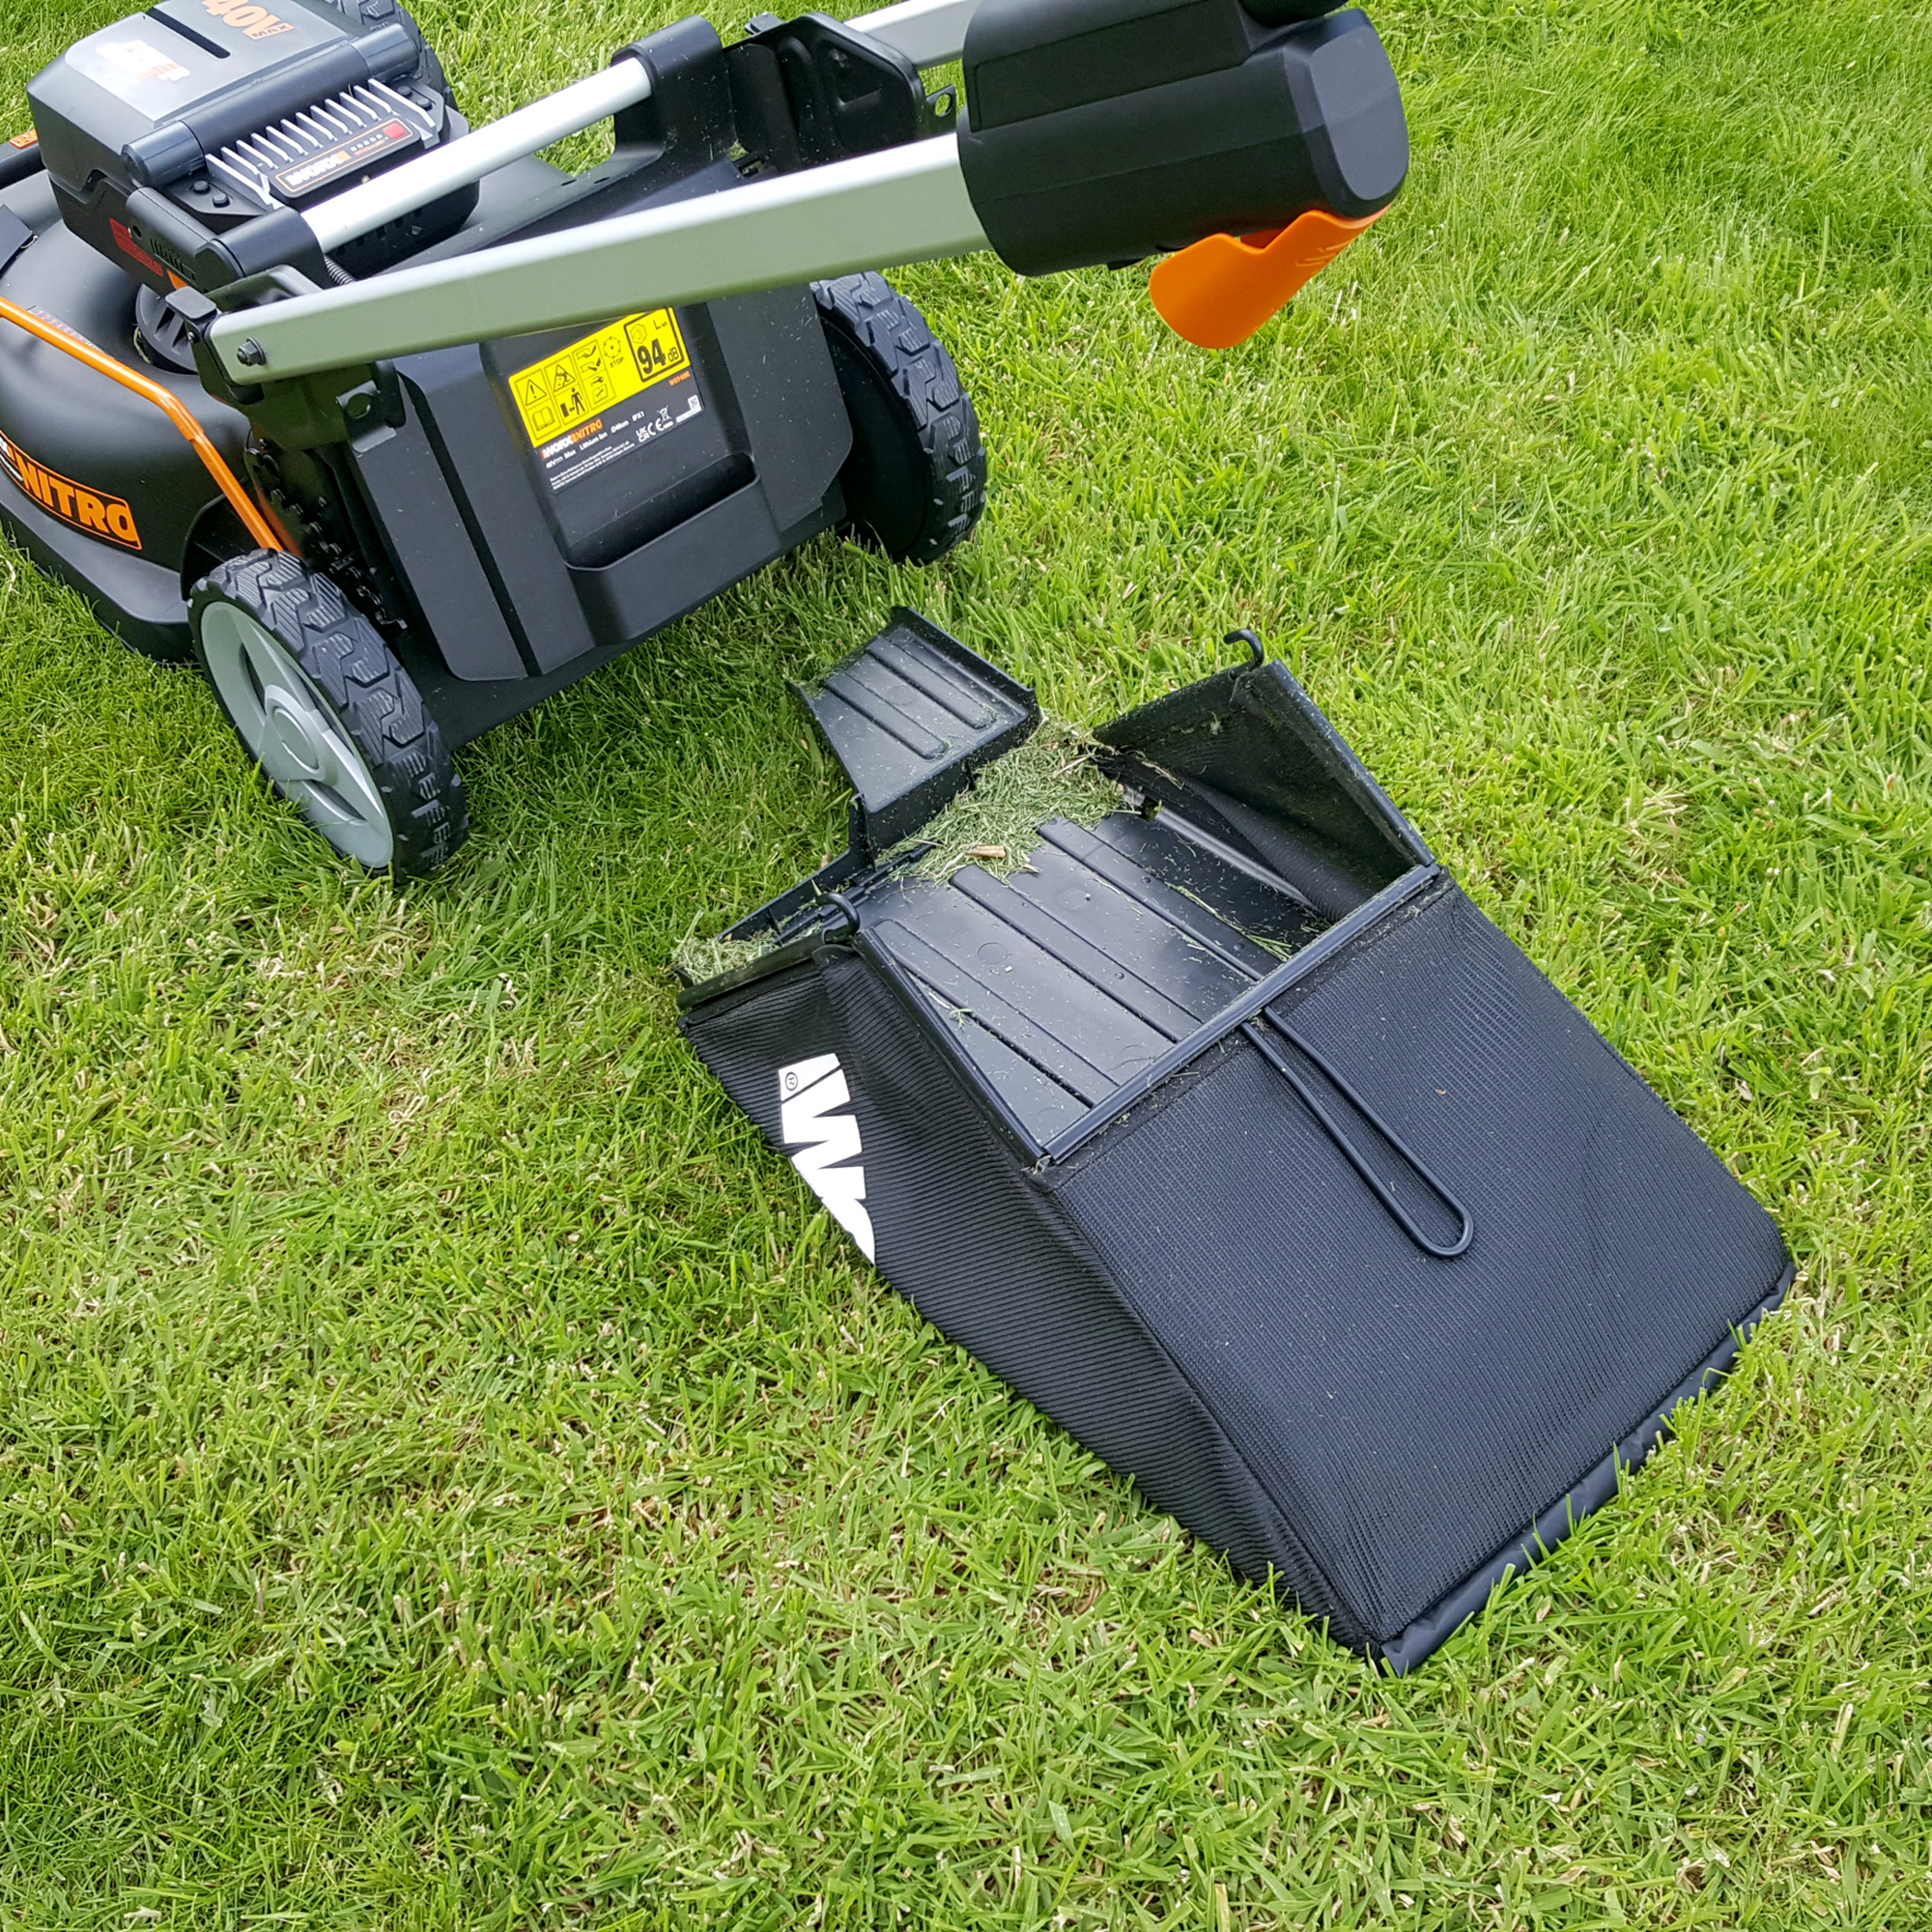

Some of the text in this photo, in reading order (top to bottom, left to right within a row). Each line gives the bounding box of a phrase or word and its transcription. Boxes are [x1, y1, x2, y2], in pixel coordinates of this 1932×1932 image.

[201, 0, 281, 40] 40V
[610, 356, 624, 368] STOP
[638, 338, 666, 374] 94
[668, 347, 679, 362] dB
[576, 418, 603, 440] NITRO
[14, 450, 138, 542] NITRO
